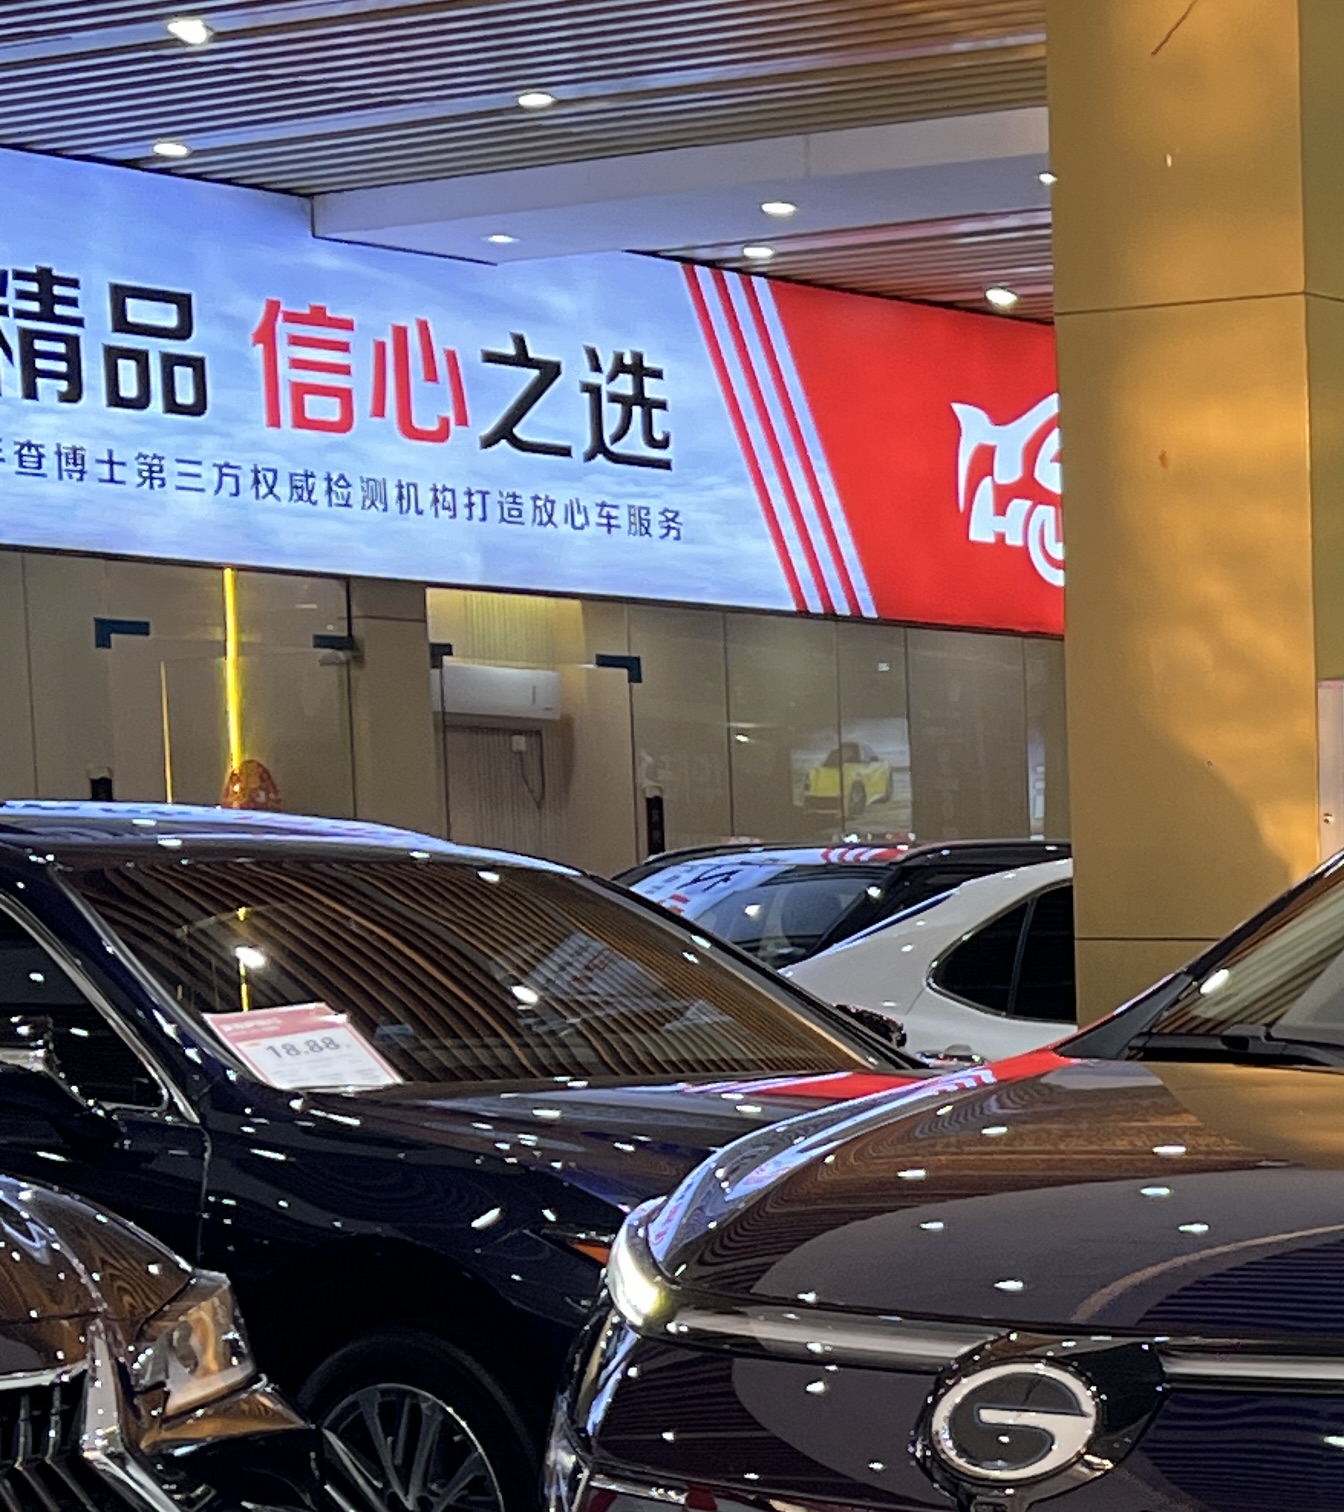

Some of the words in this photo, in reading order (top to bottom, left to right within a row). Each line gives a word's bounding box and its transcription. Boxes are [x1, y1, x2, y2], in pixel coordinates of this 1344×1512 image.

[252, 297, 673, 471] 信心之选
[0, 437, 684, 543] 查博士第三方权威检测机构打造放心车服务
